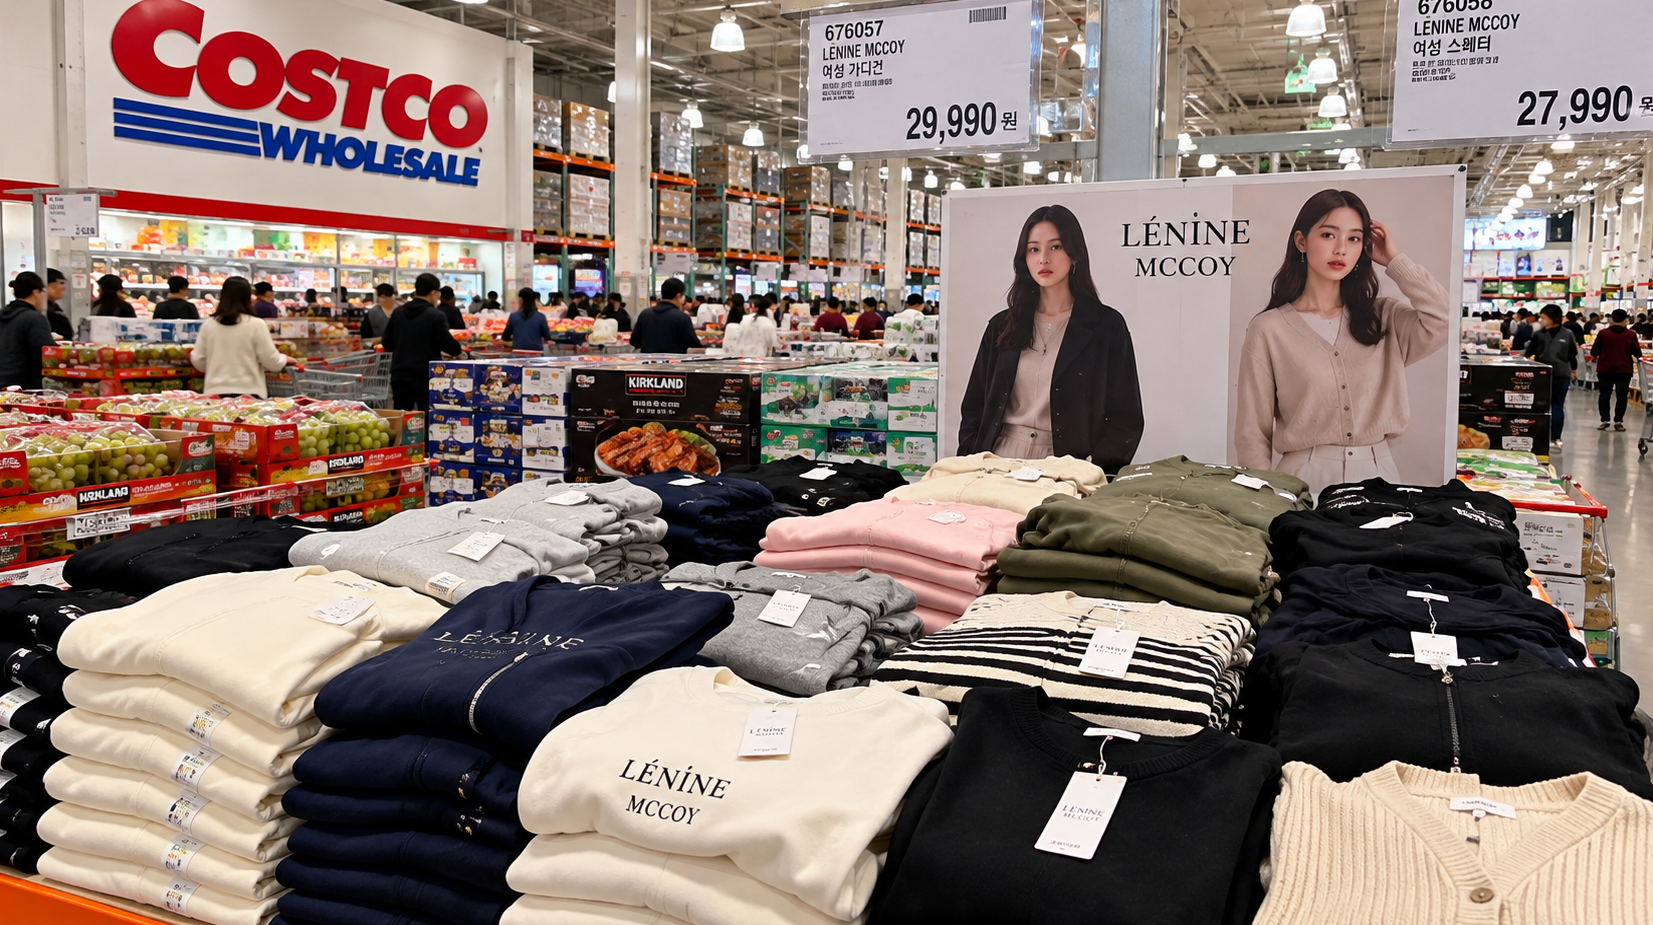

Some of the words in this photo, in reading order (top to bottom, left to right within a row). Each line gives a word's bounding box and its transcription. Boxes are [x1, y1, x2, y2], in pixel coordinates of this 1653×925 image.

[825, 19, 885, 42] 676057
[1468, 13, 1521, 33] MCCOY
[864, 39, 906, 57] MCCOY
[1413, 38, 1442, 58] 여성
[111, 0, 489, 149] COSTCO
[822, 63, 845, 80] 여성
[848, 59, 884, 78] 가디건
[1516, 85, 1634, 132] 27,990
[906, 101, 997, 145] 29,990
[259, 121, 482, 188] WHOLESALE
[1134, 256, 1237, 278] MCCOY
[628, 376, 685, 390] KIRKLAND
[625, 794, 701, 826] MCCOY
